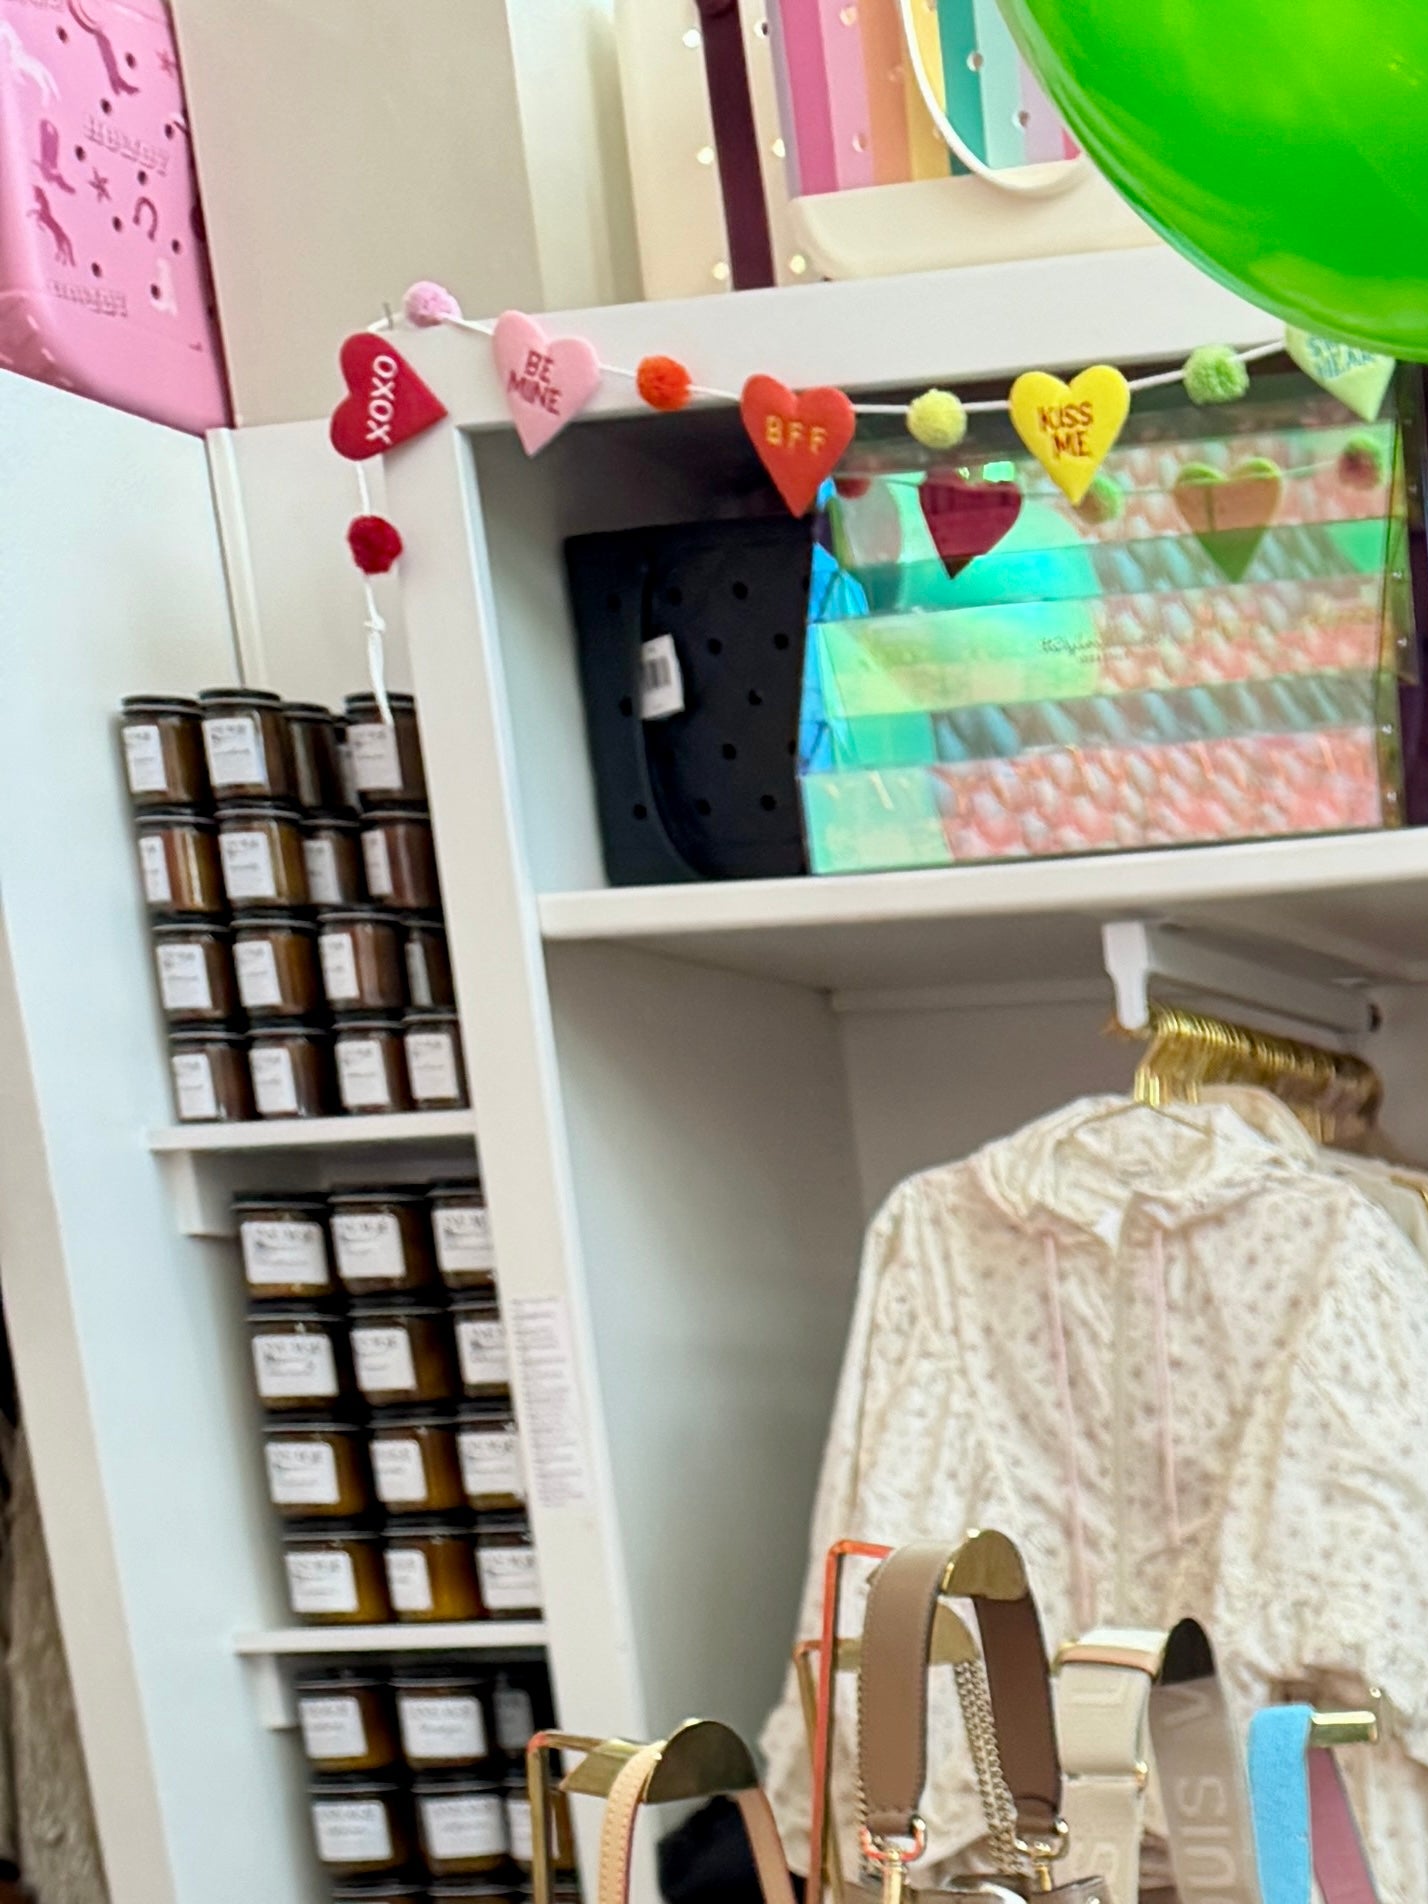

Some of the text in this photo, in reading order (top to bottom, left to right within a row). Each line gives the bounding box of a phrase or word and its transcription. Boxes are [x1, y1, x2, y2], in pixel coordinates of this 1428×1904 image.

[523, 349, 556, 380] BE
[365, 354, 397, 446] XOXO
[507, 371, 562, 417] MINE
[763, 413, 830, 455] BFF
[1037, 405, 1095, 433] KISS
[1052, 429, 1092, 460] ME
